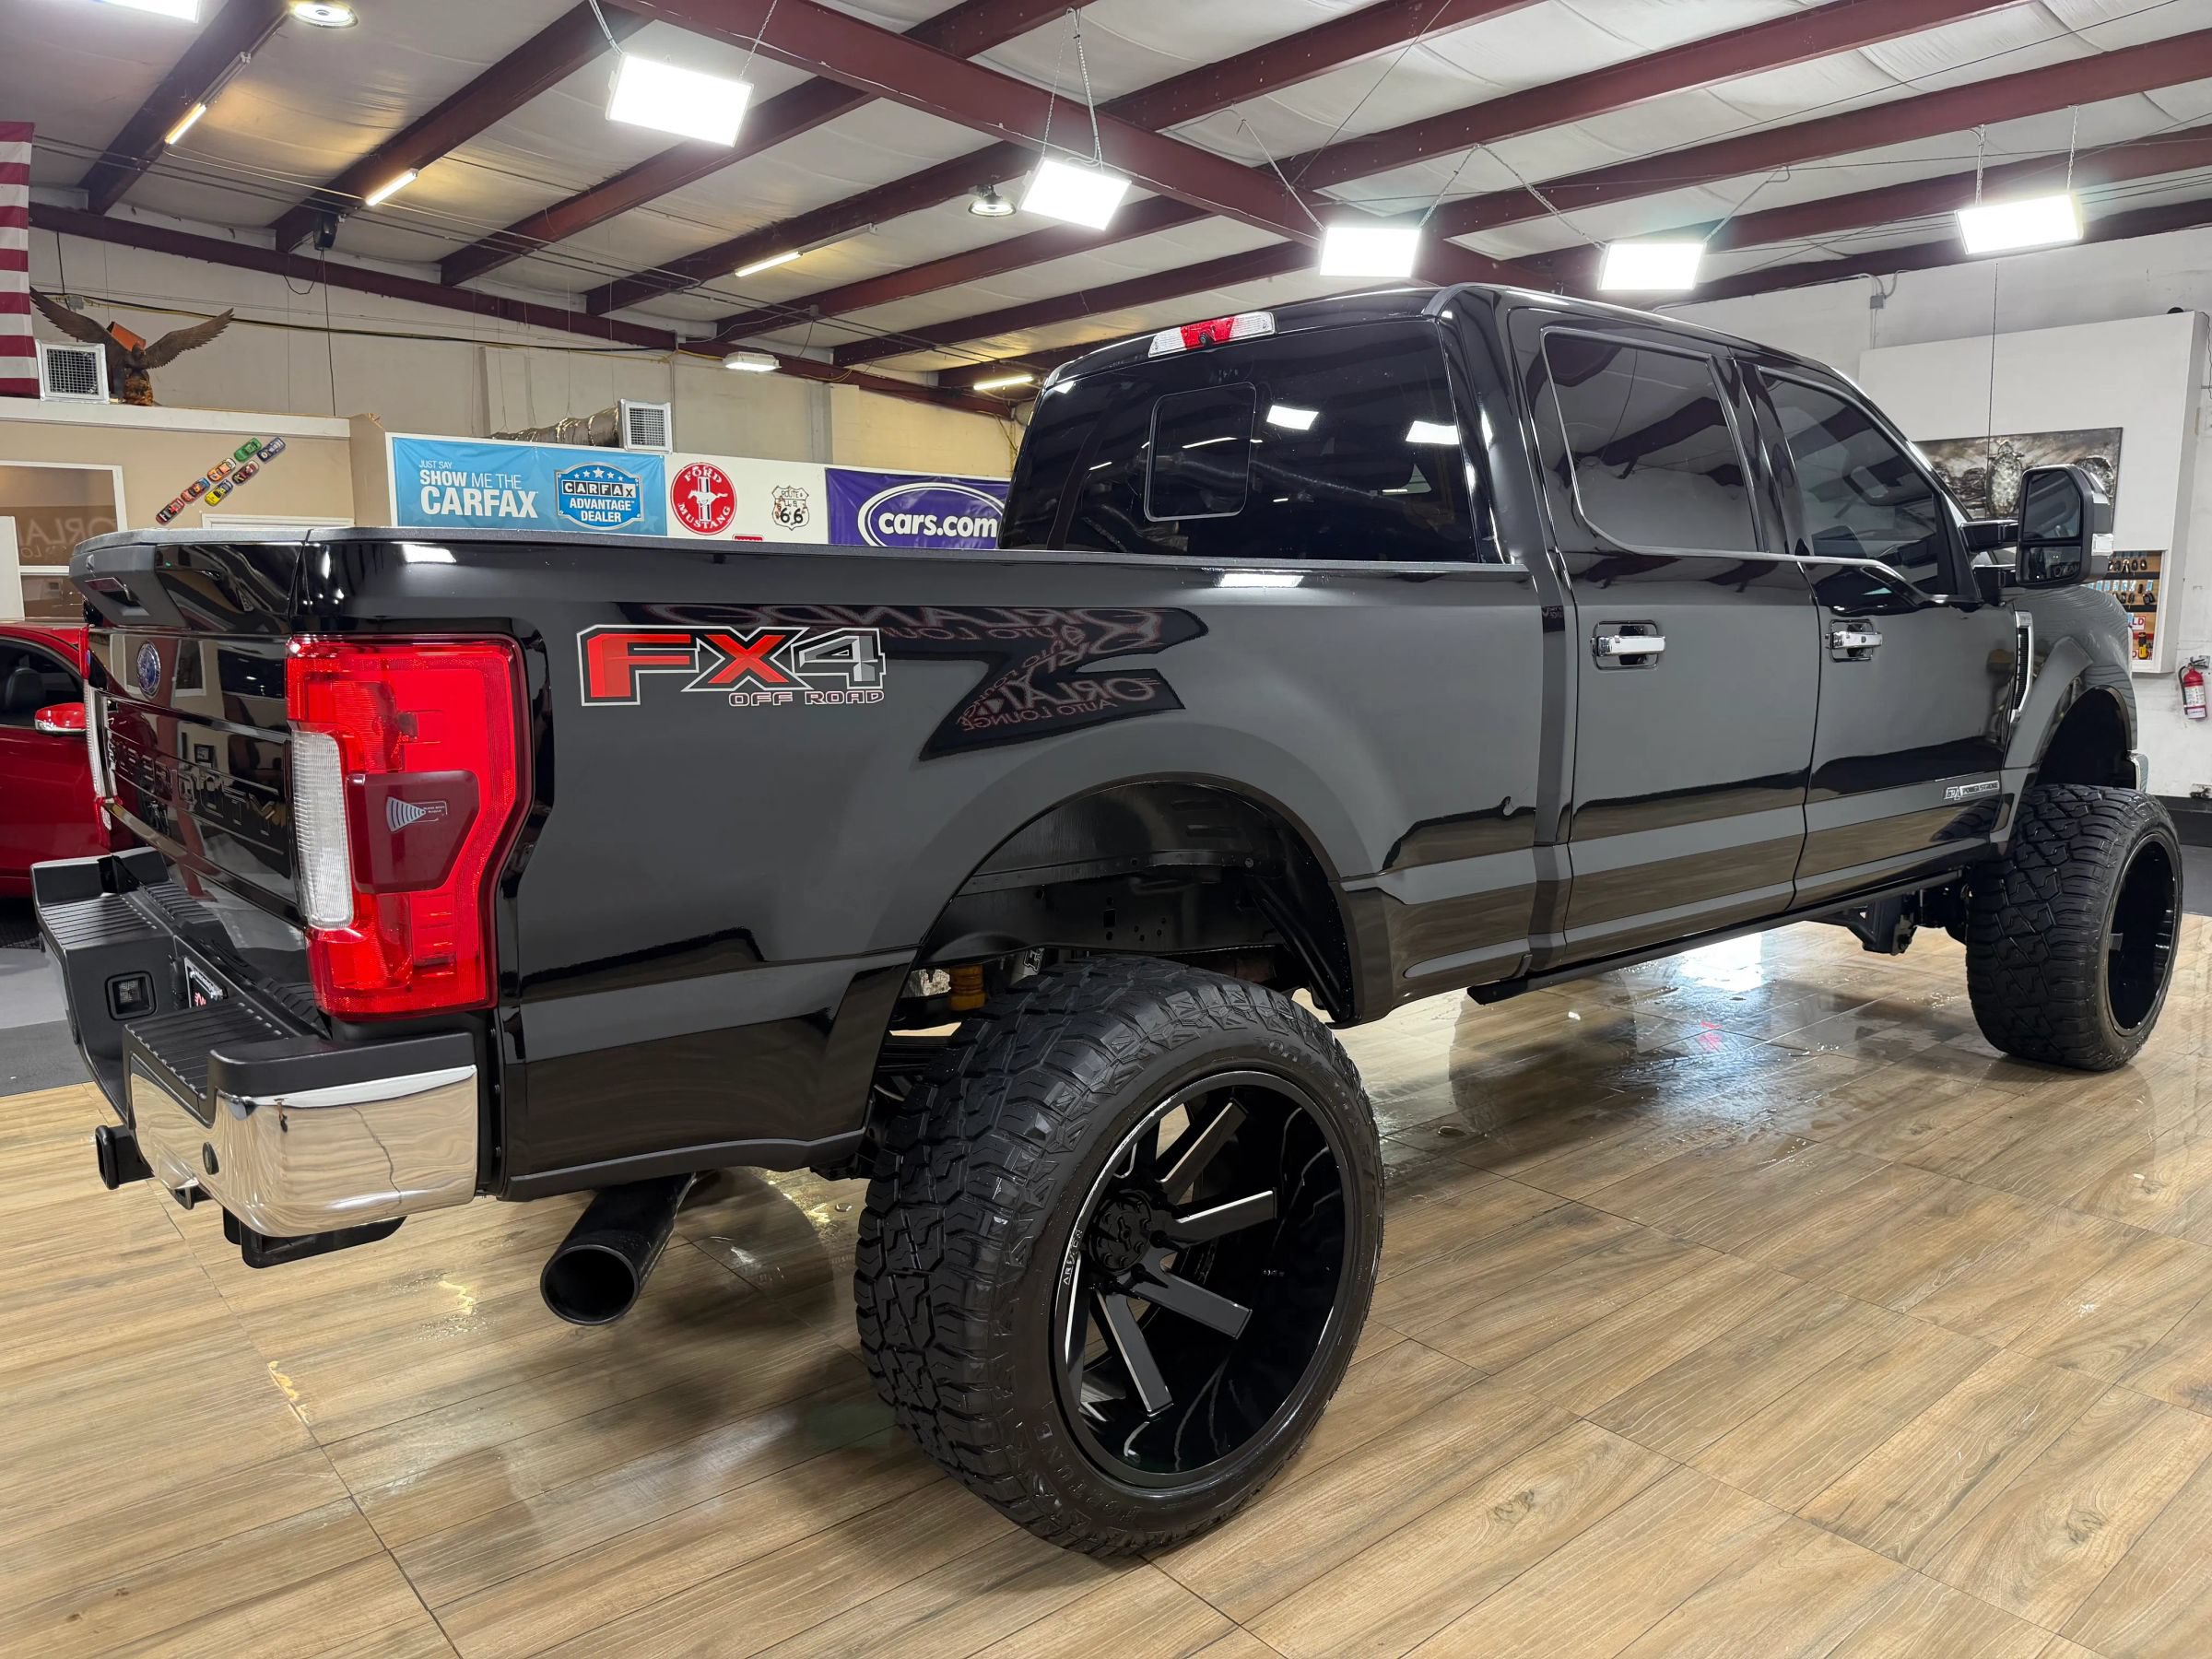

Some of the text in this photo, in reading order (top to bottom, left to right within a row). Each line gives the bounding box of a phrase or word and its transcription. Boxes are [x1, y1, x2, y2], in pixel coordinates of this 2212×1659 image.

[418, 460, 453, 470] JUST SAY
[684, 464, 723, 485] FORD
[419, 469, 523, 489] SHOW ME THE
[564, 481, 633, 498] CARFAX
[420, 485, 539, 519] CARFAX
[570, 498, 632, 512] ADVANTAGE
[581, 510, 622, 523] DEALER
[678, 501, 731, 530] MUSTANG
[781, 508, 804, 524] 66
[878, 512, 998, 539] cars.com
[576, 624, 887, 707] FX4
[728, 689, 885, 707] OFF ROAD
